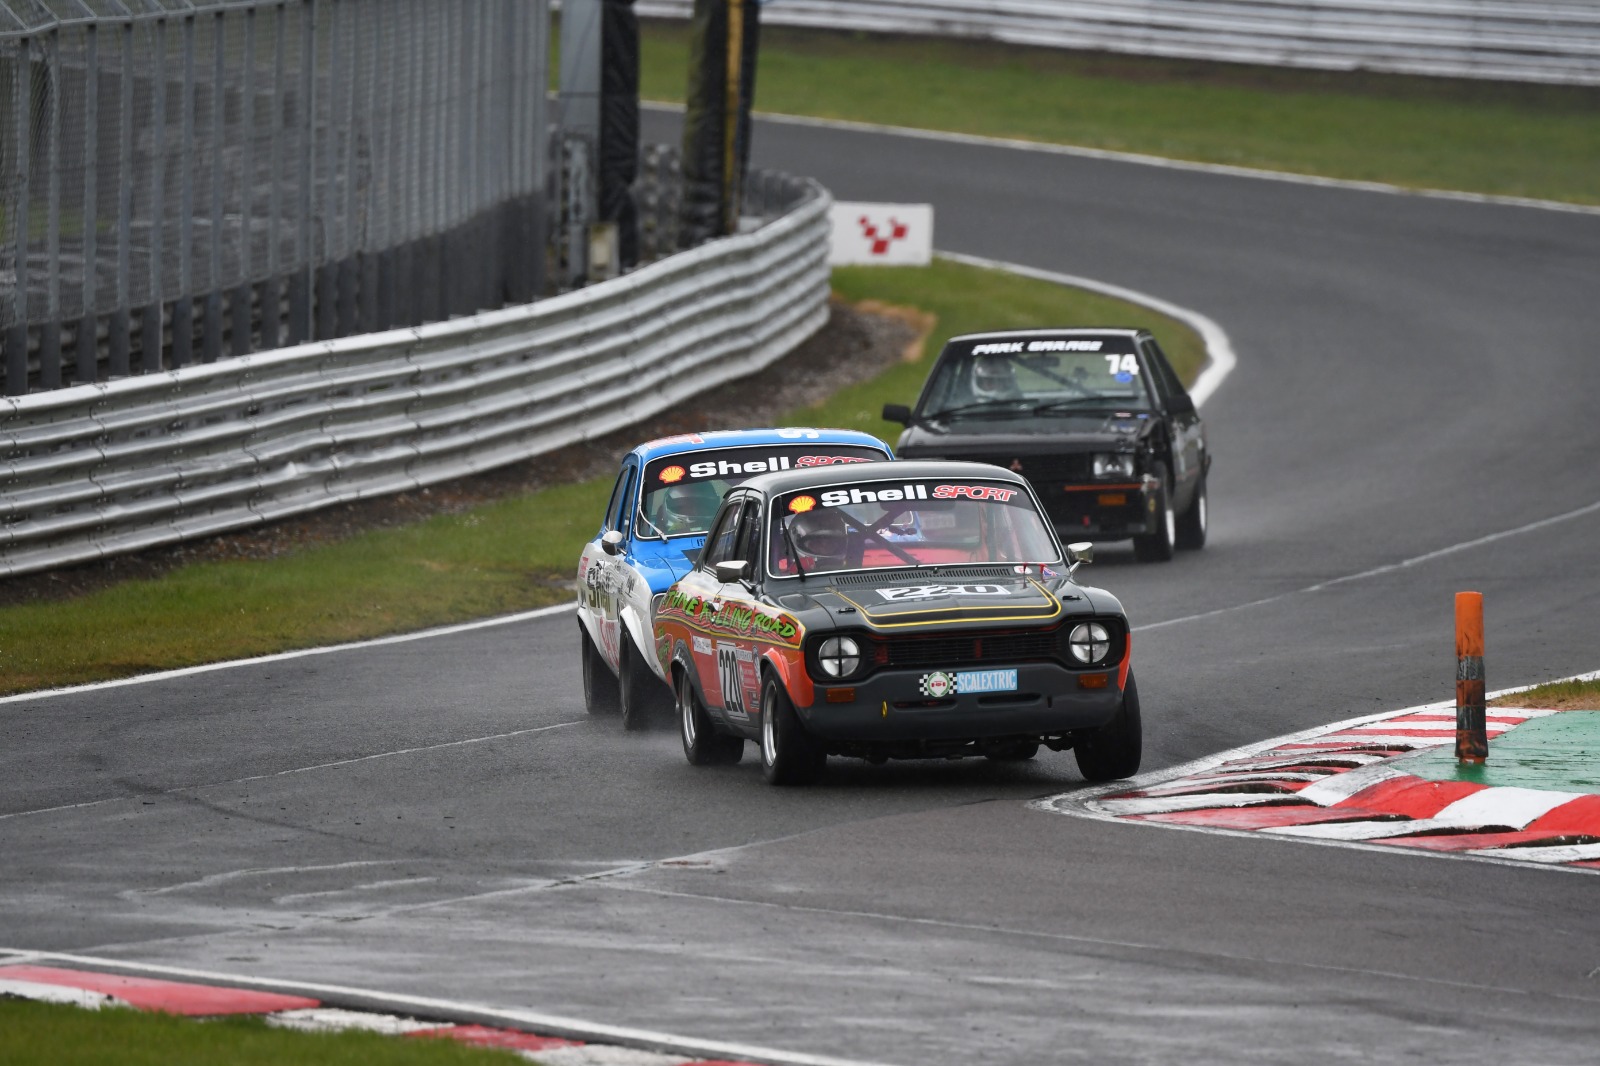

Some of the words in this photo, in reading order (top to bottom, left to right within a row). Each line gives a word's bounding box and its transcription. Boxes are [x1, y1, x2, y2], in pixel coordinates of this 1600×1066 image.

[972, 342, 1025, 355] PARK
[1027, 340, 1103, 351] GARAGE
[1104, 353, 1139, 375] 74
[689, 456, 790, 478] Shell
[795, 455, 875, 469] SPO
[820, 484, 928, 507] Shell
[932, 485, 1017, 502] SPORT
[889, 584, 999, 598] 220
[699, 600, 753, 632] RLLING
[753, 612, 797, 638] ROAD
[719, 648, 745, 714] 220
[958, 671, 1016, 692] SCALEXTRIC
